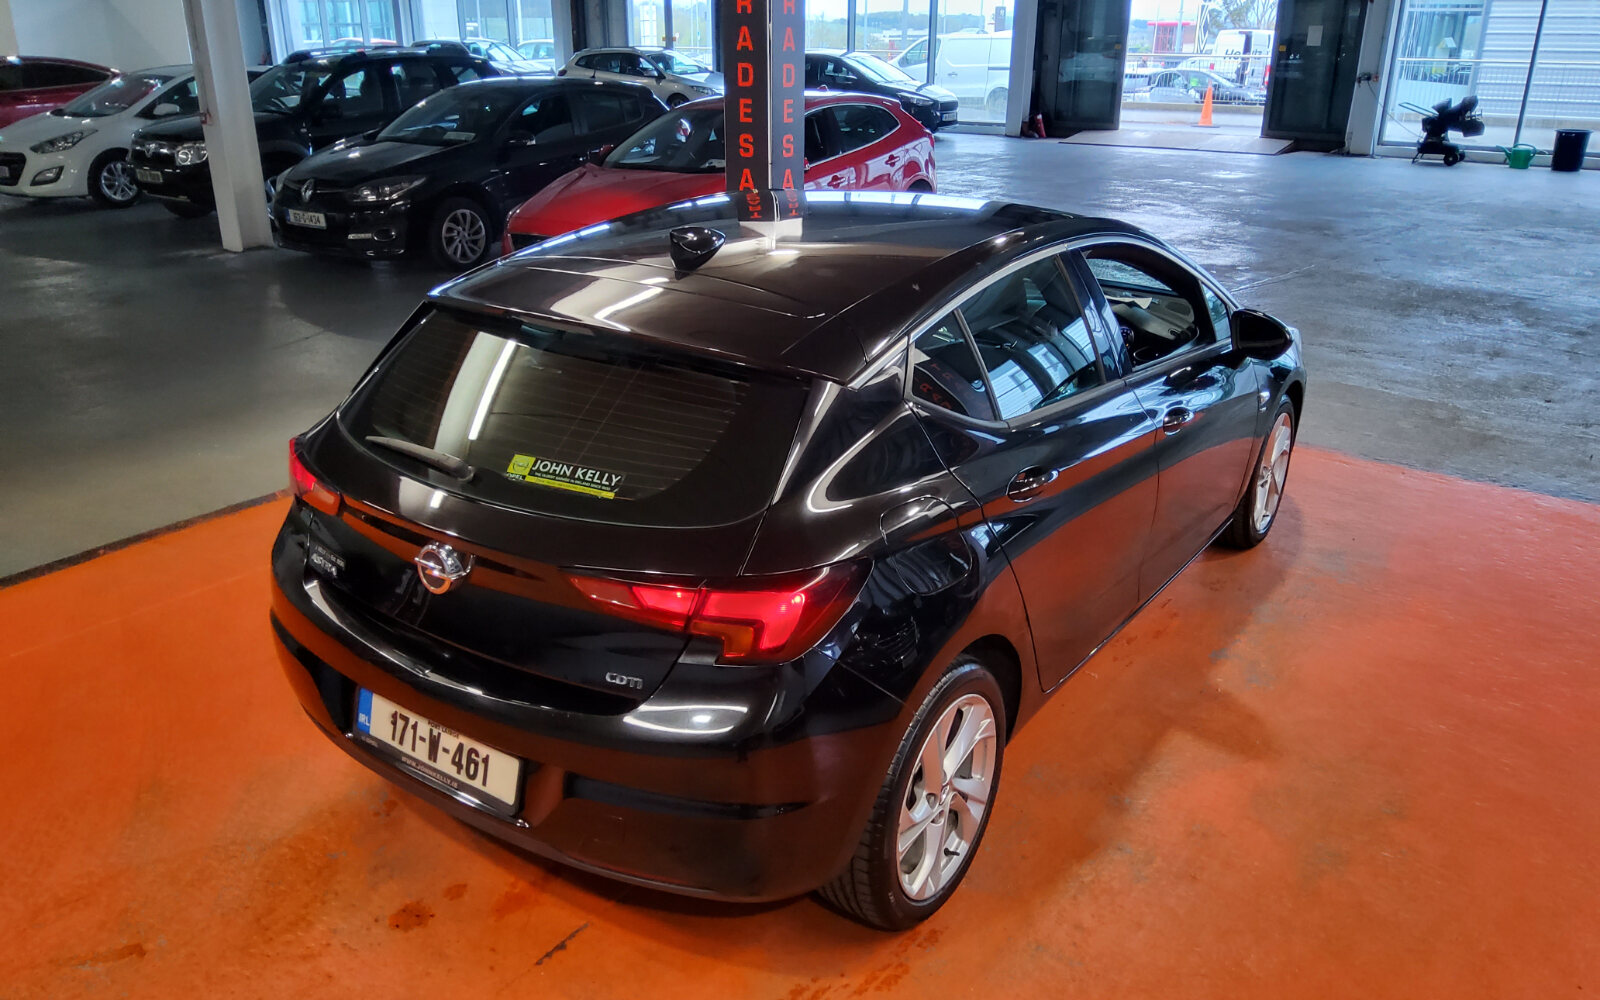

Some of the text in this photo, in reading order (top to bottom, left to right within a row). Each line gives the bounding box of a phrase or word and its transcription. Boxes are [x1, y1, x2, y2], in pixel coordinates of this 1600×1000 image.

[532, 459, 621, 486] JOHN KELLY
[359, 712, 370, 726] IRL
[391, 710, 490, 787] 171-W-461
